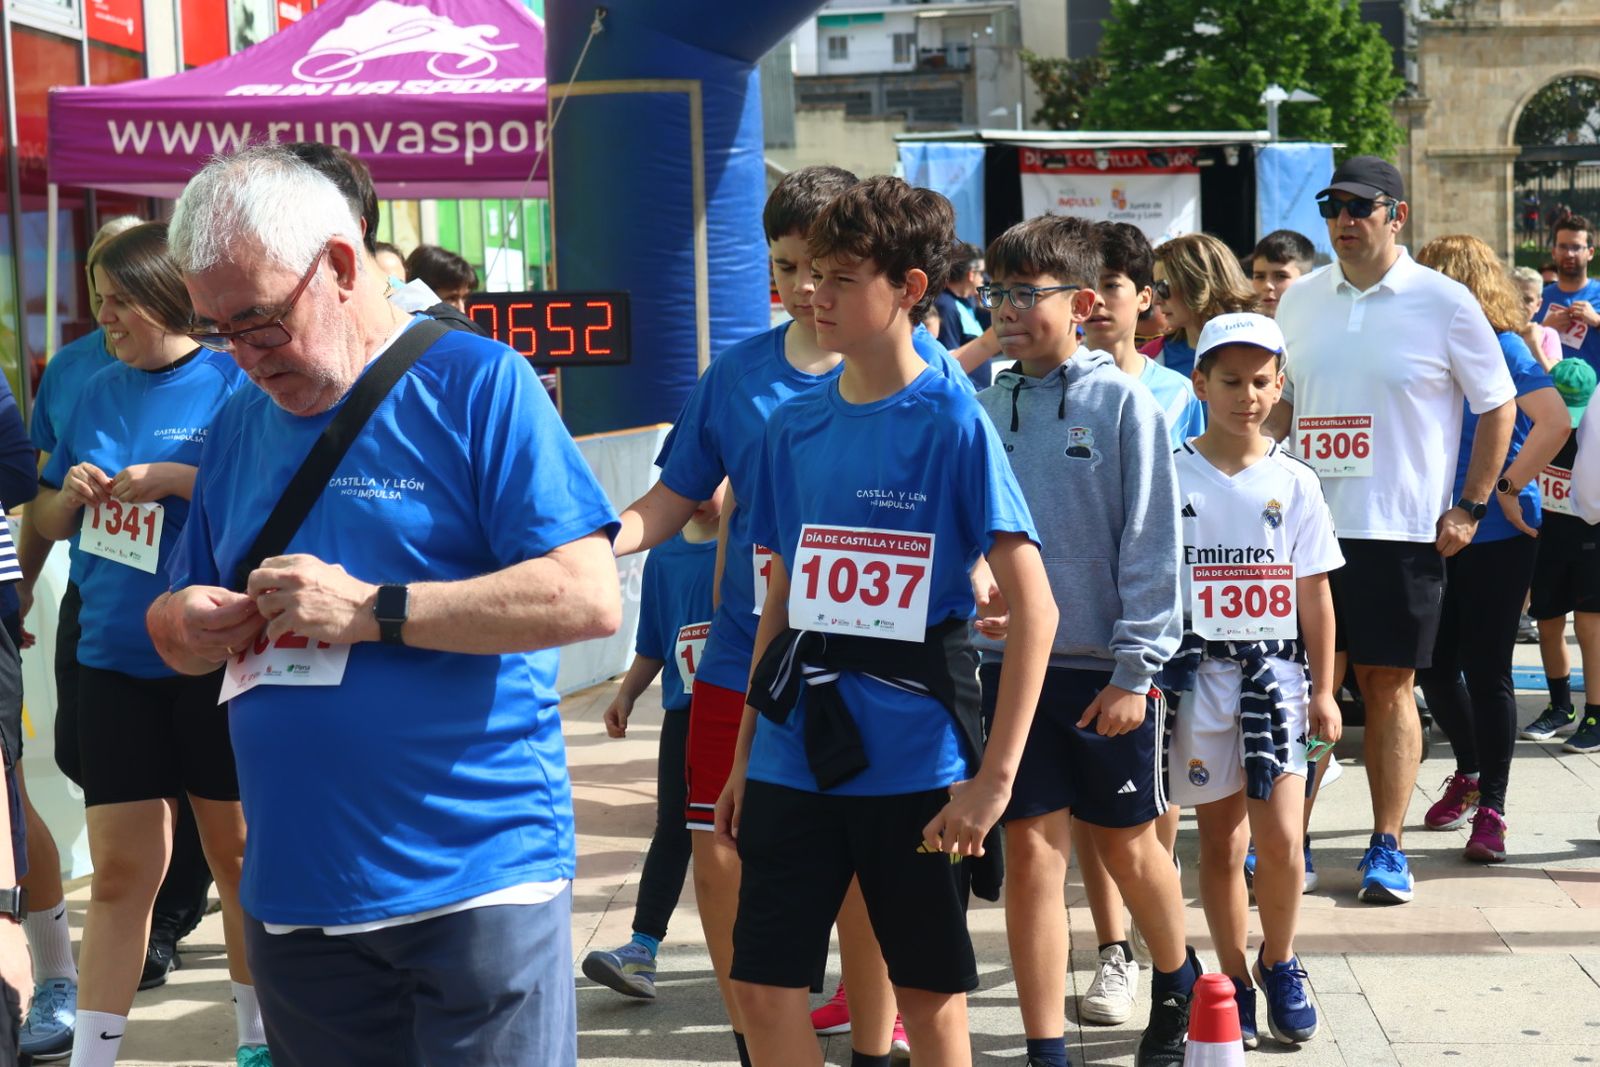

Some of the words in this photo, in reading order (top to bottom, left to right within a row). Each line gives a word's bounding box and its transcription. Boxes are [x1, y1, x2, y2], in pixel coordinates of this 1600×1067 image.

[107, 118, 548, 165] wwwrunvaspor
[1076, 153, 1142, 167] CATILLA
[1311, 419, 1319, 427] DE
[1319, 418, 1347, 427] CASTILLA
[1300, 431, 1370, 460] 1306
[328, 477, 376, 488] CASTILLA
[382, 478, 390, 489] Y
[394, 477, 425, 491] LEÓN
[340, 488, 357, 496] NOS
[357, 489, 402, 500] IMPULSA
[899, 491, 906, 500] Y
[879, 500, 916, 511] IMPULSA
[806, 532, 822, 543] DÍA
[824, 534, 838, 544] DE
[840, 536, 887, 549] CASTILLA
[888, 540, 896, 549] Y
[897, 540, 927, 552] LEÓN
[1183, 544, 1275, 565] Emirates
[1196, 568, 1210, 577] DÍA
[1211, 569, 1222, 577] DE
[1224, 568, 1261, 577] CASTILLA
[1261, 568, 1267, 576] Y
[1268, 567, 1290, 576] LEÓN
[801, 554, 926, 609] 1037
[1198, 584, 1292, 619] 1308
